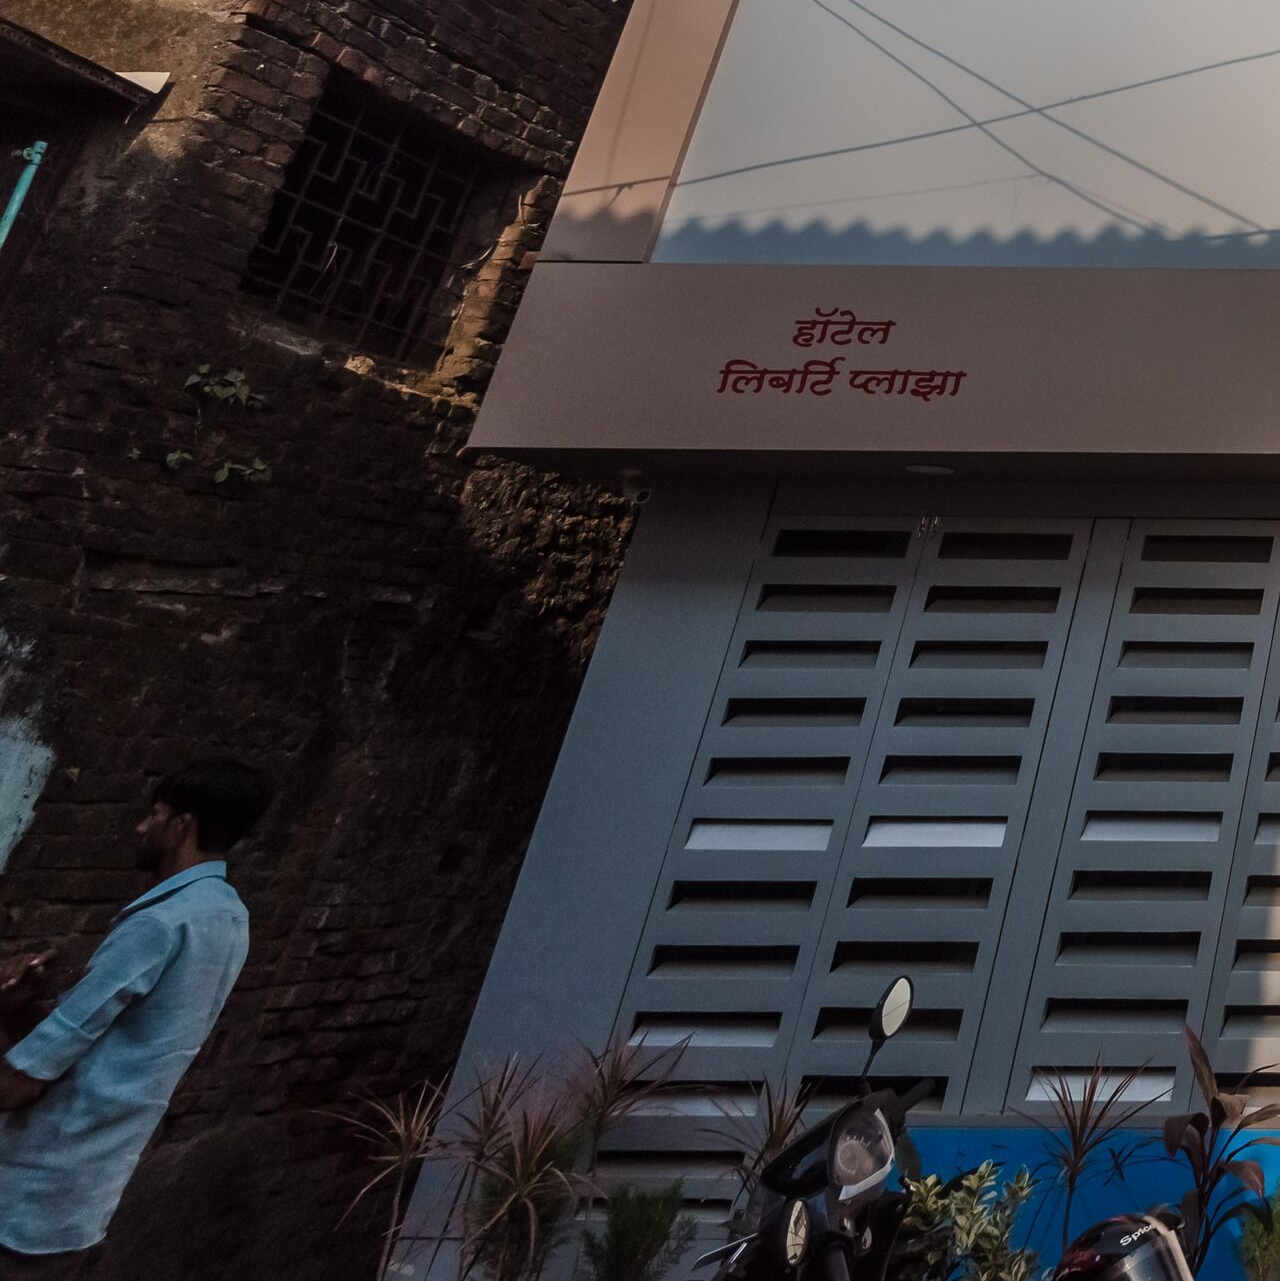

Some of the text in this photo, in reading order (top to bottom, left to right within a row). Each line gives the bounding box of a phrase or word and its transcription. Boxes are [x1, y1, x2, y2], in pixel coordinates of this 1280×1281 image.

[792, 307, 896, 347] हॉटेल
[716, 356, 967, 402] लिबर्टि प्लाझा
